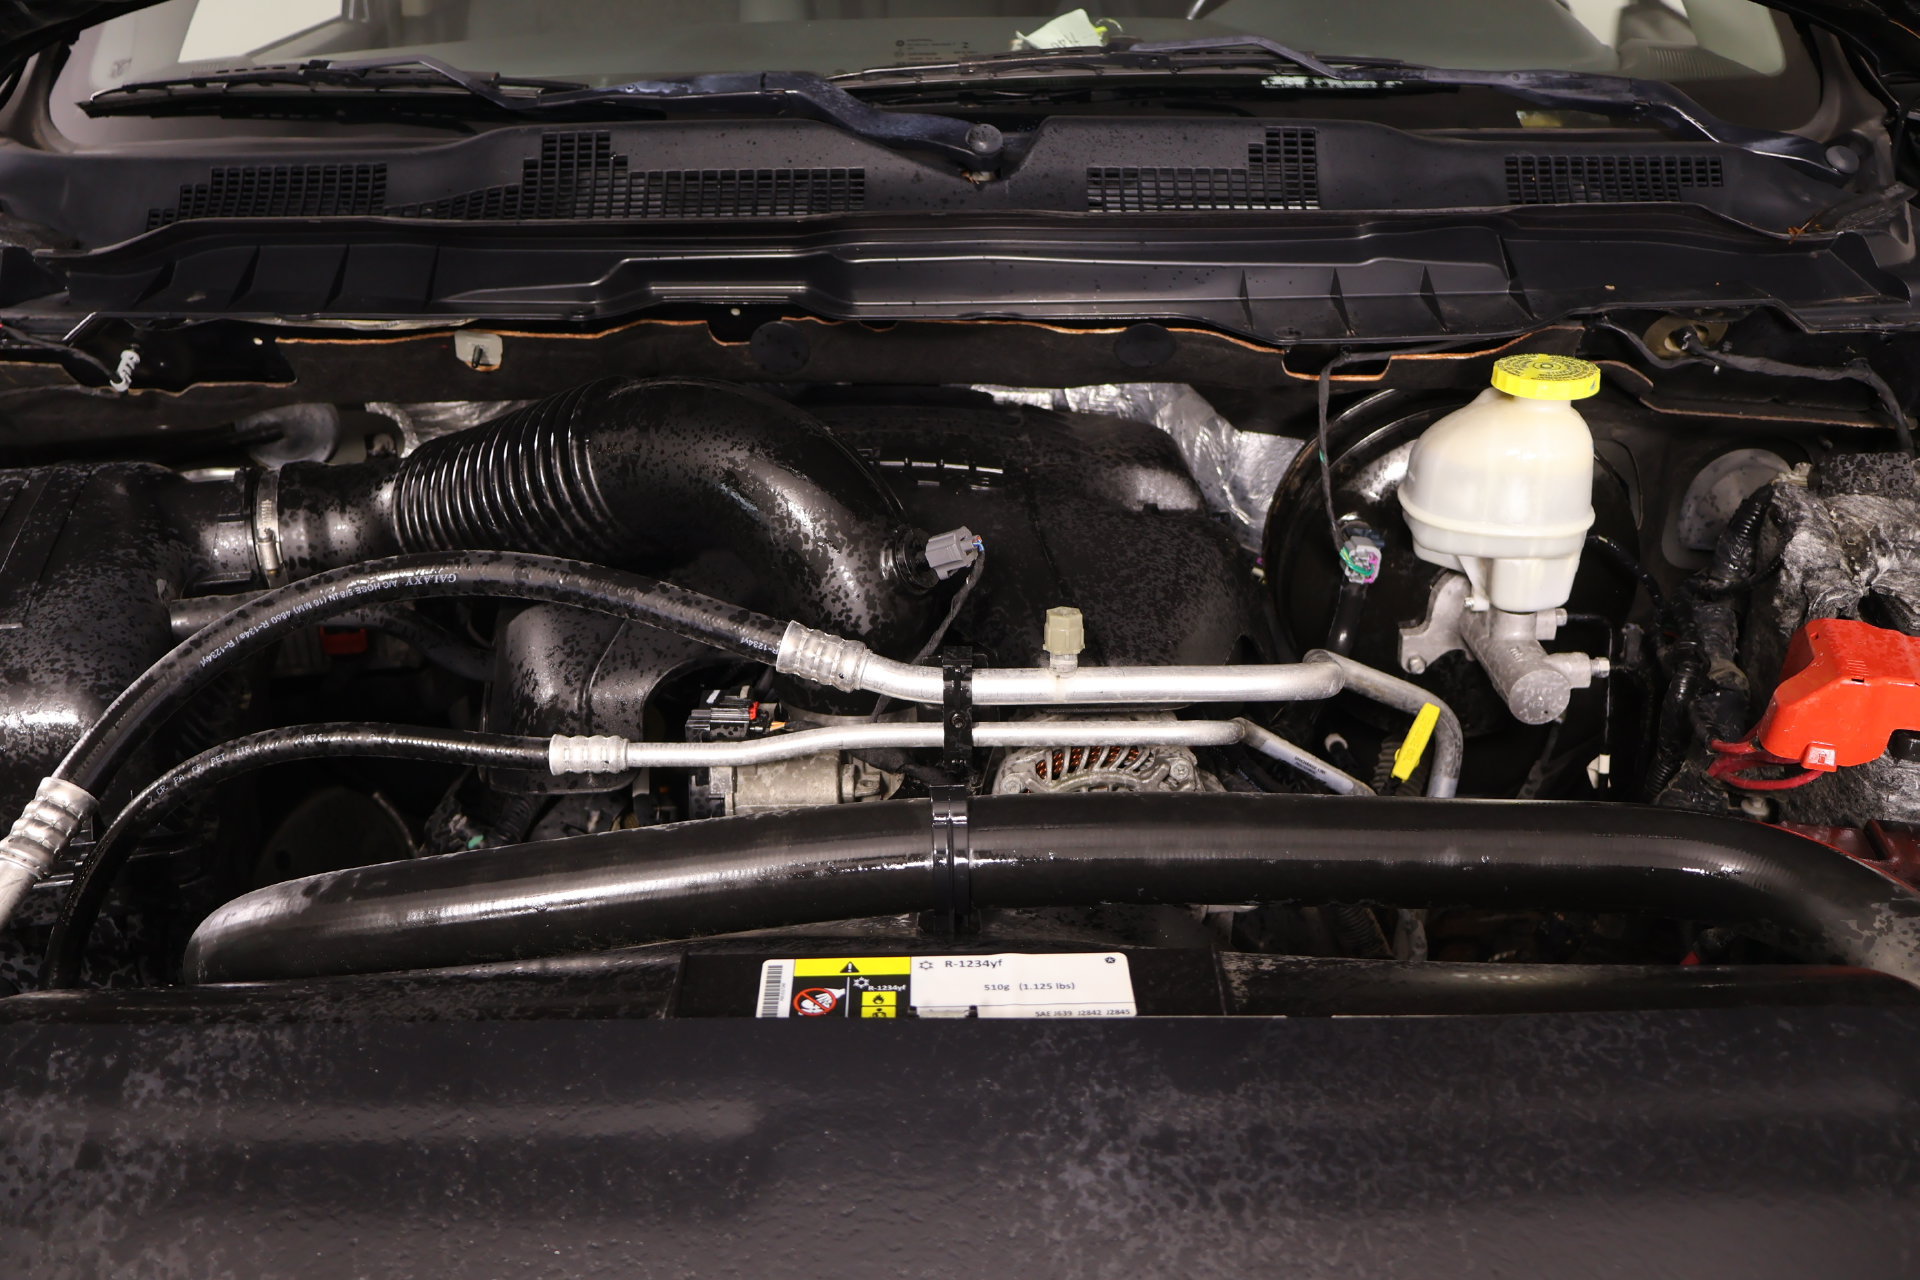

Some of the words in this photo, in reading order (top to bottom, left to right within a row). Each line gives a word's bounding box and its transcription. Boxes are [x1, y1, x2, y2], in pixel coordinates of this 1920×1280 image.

[382, 579, 398, 589] A/C
[405, 573, 457, 587] GALAXY
[355, 582, 381, 595] HOSE
[740, 637, 779, 655] R-1234yf
[945, 958, 1003, 968] R-1234yf
[867, 984, 906, 992] R-1234yf
[984, 983, 1010, 991] 510g
[1019, 982, 1053, 991] (1.125
[1056, 982, 1076, 990] lbs)
